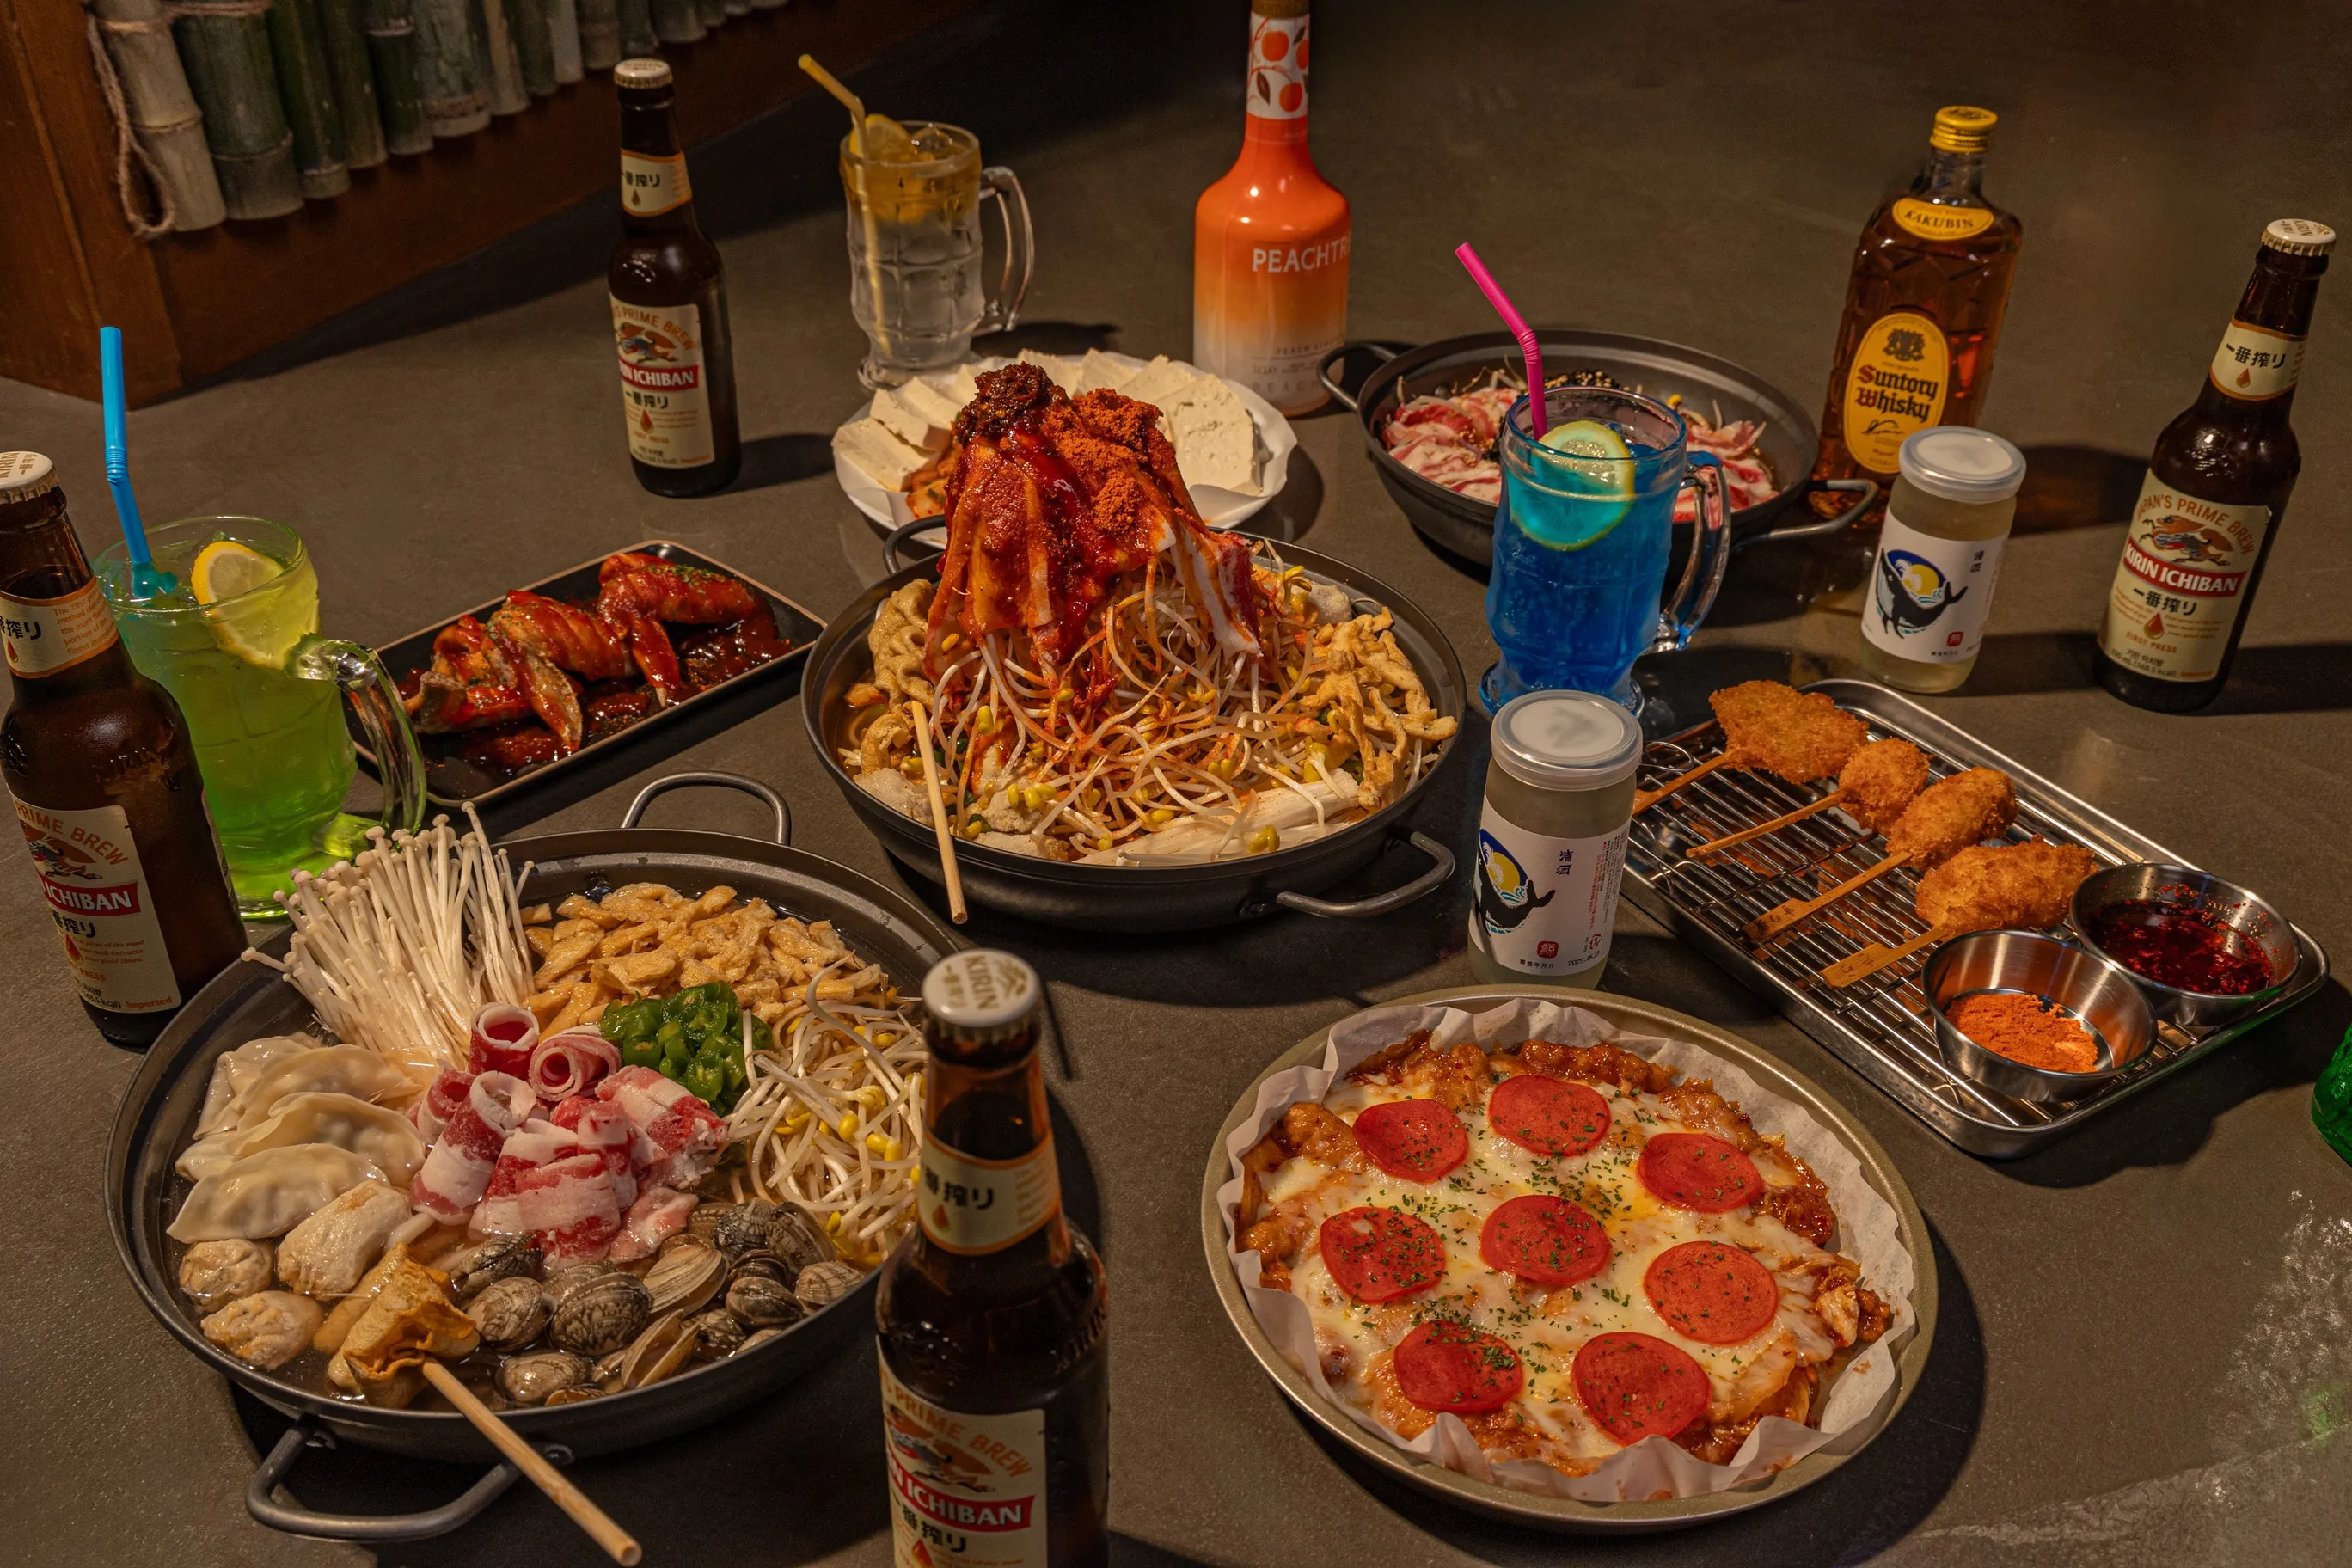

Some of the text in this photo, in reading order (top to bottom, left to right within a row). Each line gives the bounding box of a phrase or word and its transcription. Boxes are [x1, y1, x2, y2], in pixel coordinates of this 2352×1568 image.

[1904, 210, 1974, 229] KAKUBIN
[2226, 344, 2286, 369] 一番搾り
[633, 368, 695, 386] ICHIBAN
[1857, 364, 1939, 401] Suntory
[1855, 386, 1932, 423] Whisky
[2177, 498, 2230, 526] PRIME
[2226, 520, 2255, 555] BREW
[2125, 544, 2239, 593] KIRIN ICHIBAN
[2133, 587, 2198, 616] 一番搾り
[15, 800, 129, 866] PRIME BREW
[45, 883, 132, 911] ICHIBAN
[895, 1387, 1032, 1478] PRIME BREW
[907, 1478, 1022, 1527] ICHIBAN
